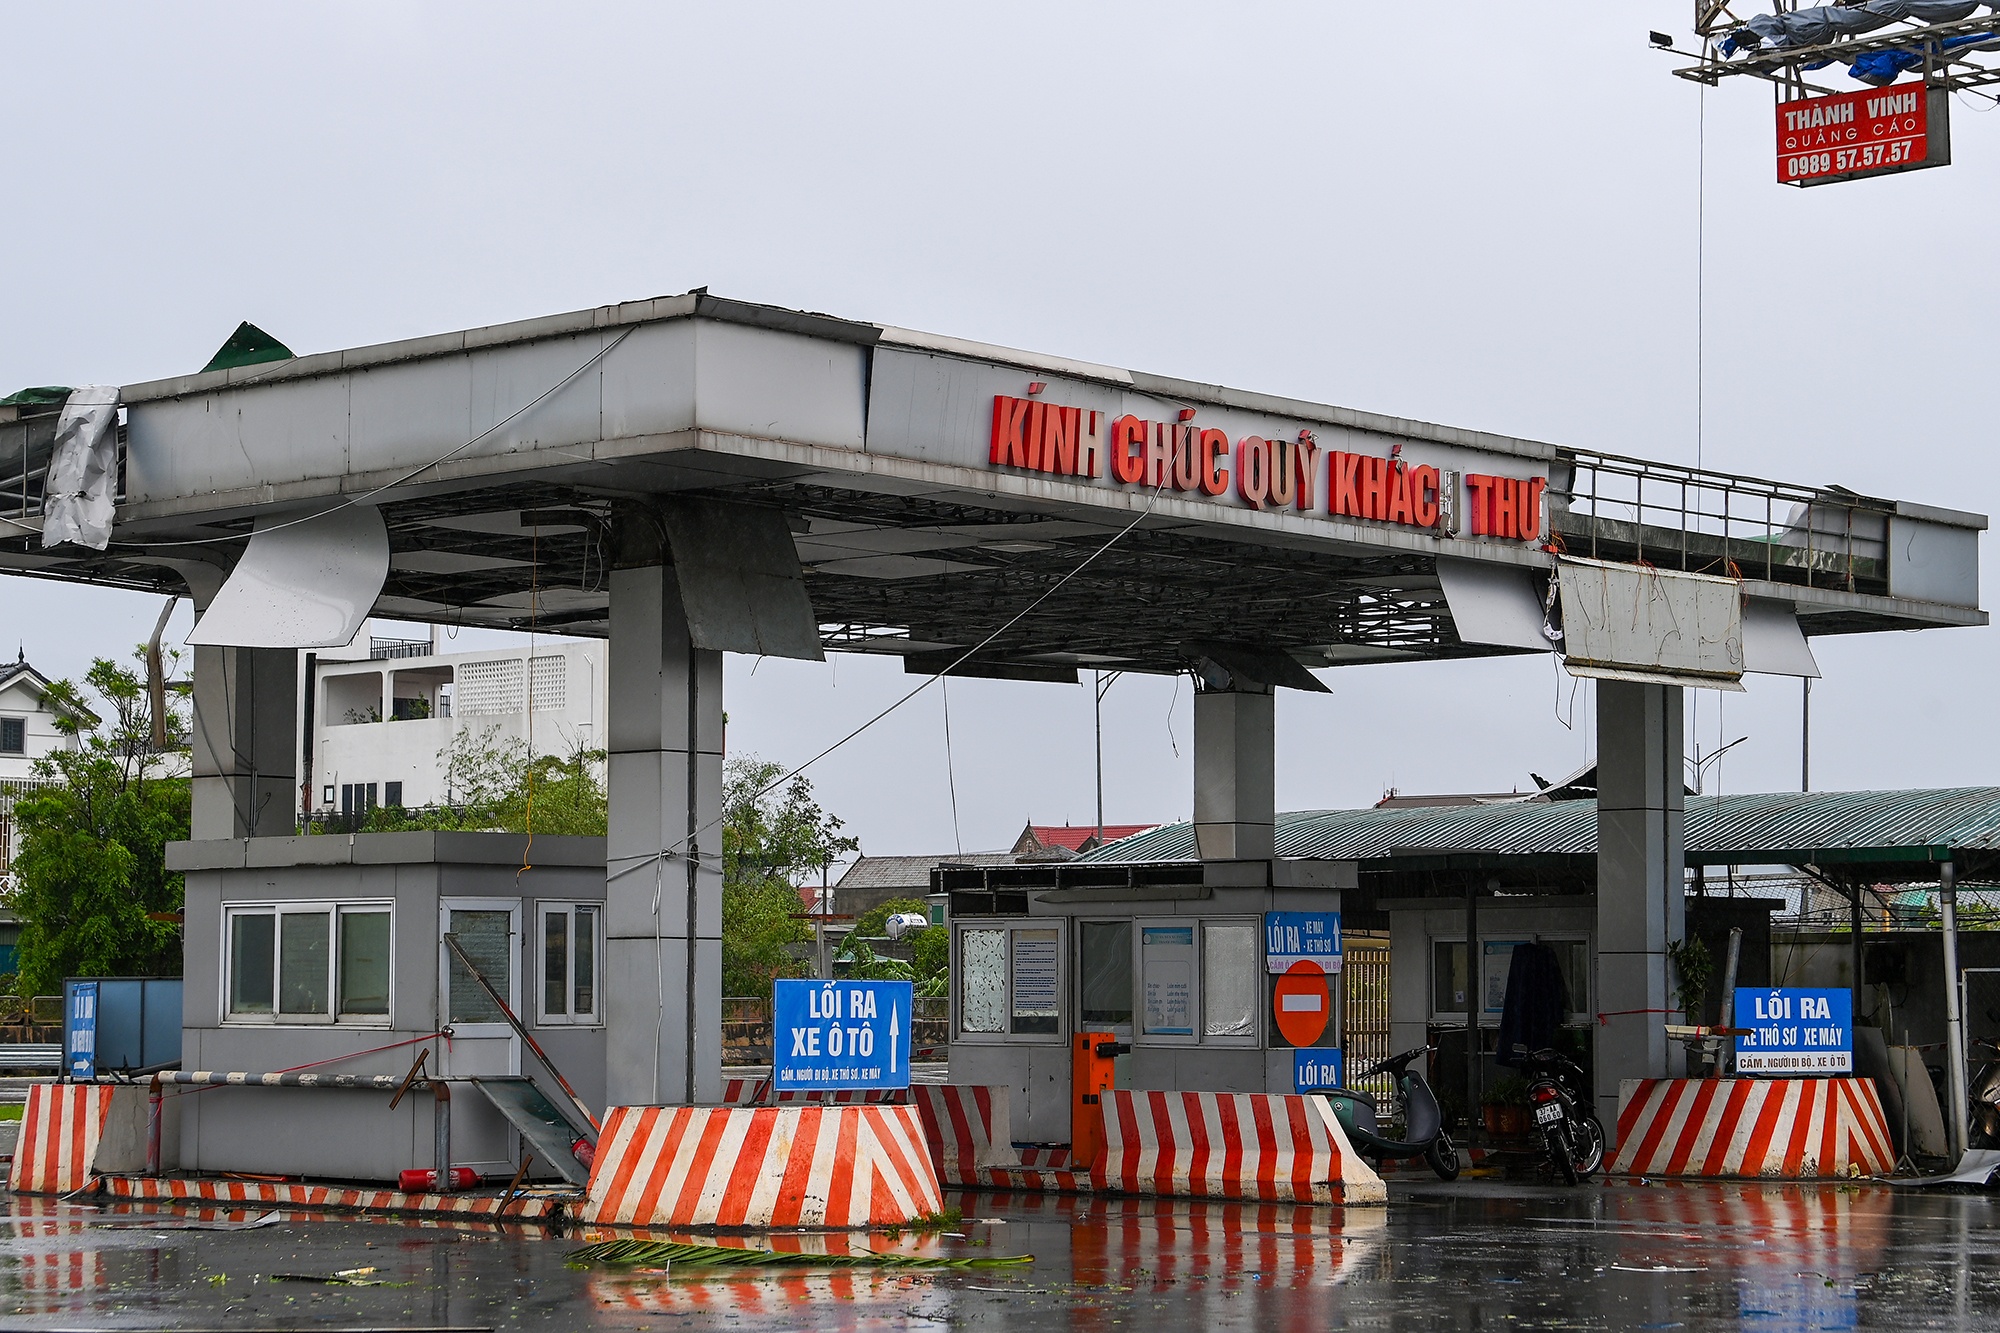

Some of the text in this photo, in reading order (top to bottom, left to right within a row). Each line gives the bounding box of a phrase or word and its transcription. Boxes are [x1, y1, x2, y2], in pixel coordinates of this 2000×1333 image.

[1785, 92, 1917, 131] THÀNH VINH
[1785, 117, 1916, 149] QUẢNG CÁO
[1788, 141, 1912, 177] 0989 57.57.57
[989, 382, 1104, 478] KÍNH
[1111, 409, 1229, 496] CHÚC
[1236, 429, 1322, 511] QUÝ
[1267, 916, 1301, 953] LỐI RA
[1305, 920, 1312, 934] XE
[1306, 939, 1314, 953] XE
[809, 980, 877, 1019] LỐI RA
[1755, 989, 1831, 1019] LỐI RA
[791, 1021, 874, 1057] XE Ô TÔ
[1759, 1022, 1779, 1046] THÔ
[1782, 1026, 1797, 1046] SƠ
[1804, 1027, 1818, 1046] XE
[1819, 1023, 1842, 1046] MÁY
[832, 1068, 839, 1080] XE
[861, 1068, 868, 1080] XE
[1298, 1059, 1337, 1085] LỐI RA
[1768, 1055, 1791, 1068] NGƯỜI
[1817, 1057, 1827, 1067] XE
